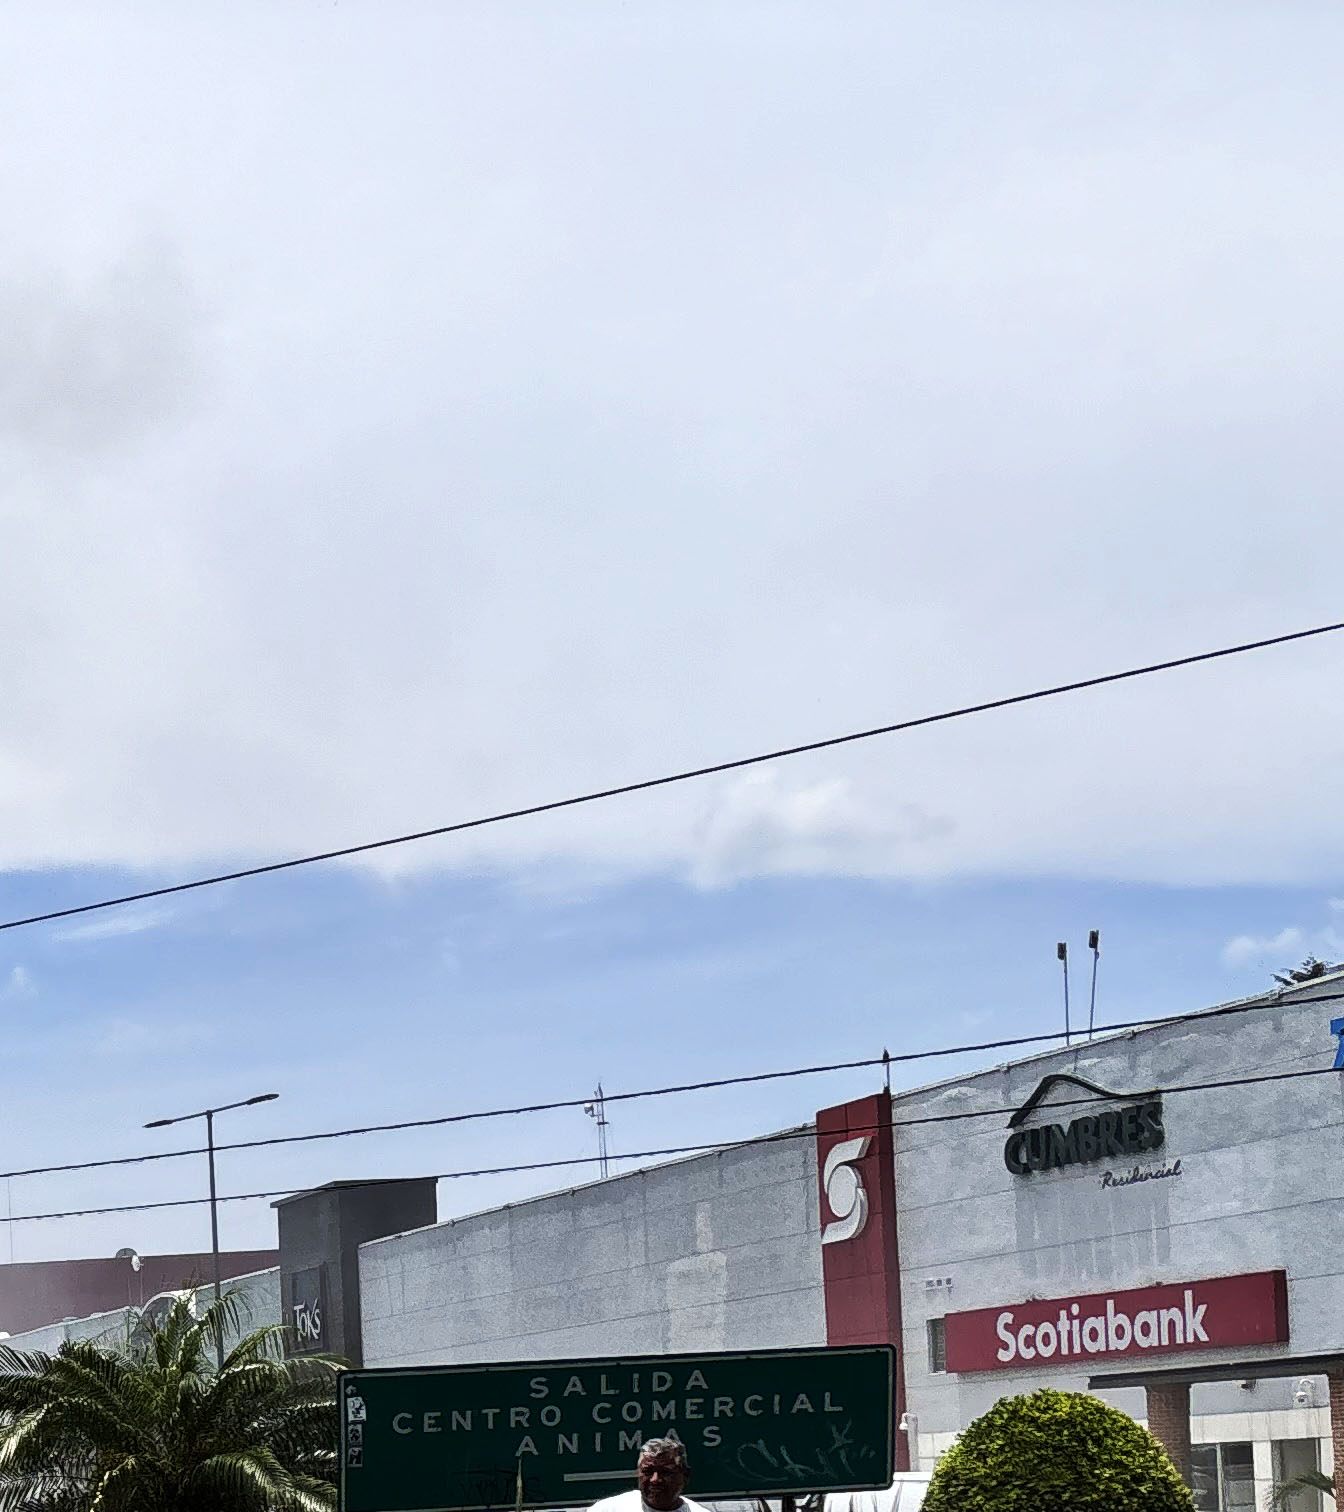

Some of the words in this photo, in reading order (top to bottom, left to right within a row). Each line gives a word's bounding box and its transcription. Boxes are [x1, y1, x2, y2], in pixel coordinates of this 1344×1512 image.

[1005, 1102, 1165, 1175] CUMBRES
[1101, 1160, 1182, 1189] Residencial
[996, 1289, 1210, 1363] Scotiabank
[529, 1369, 711, 1399] SALIDA
[392, 1405, 563, 1435] CENTRO
[592, 1391, 845, 1424] COMERCIAL
[514, 1425, 723, 1457] ANIMAS
